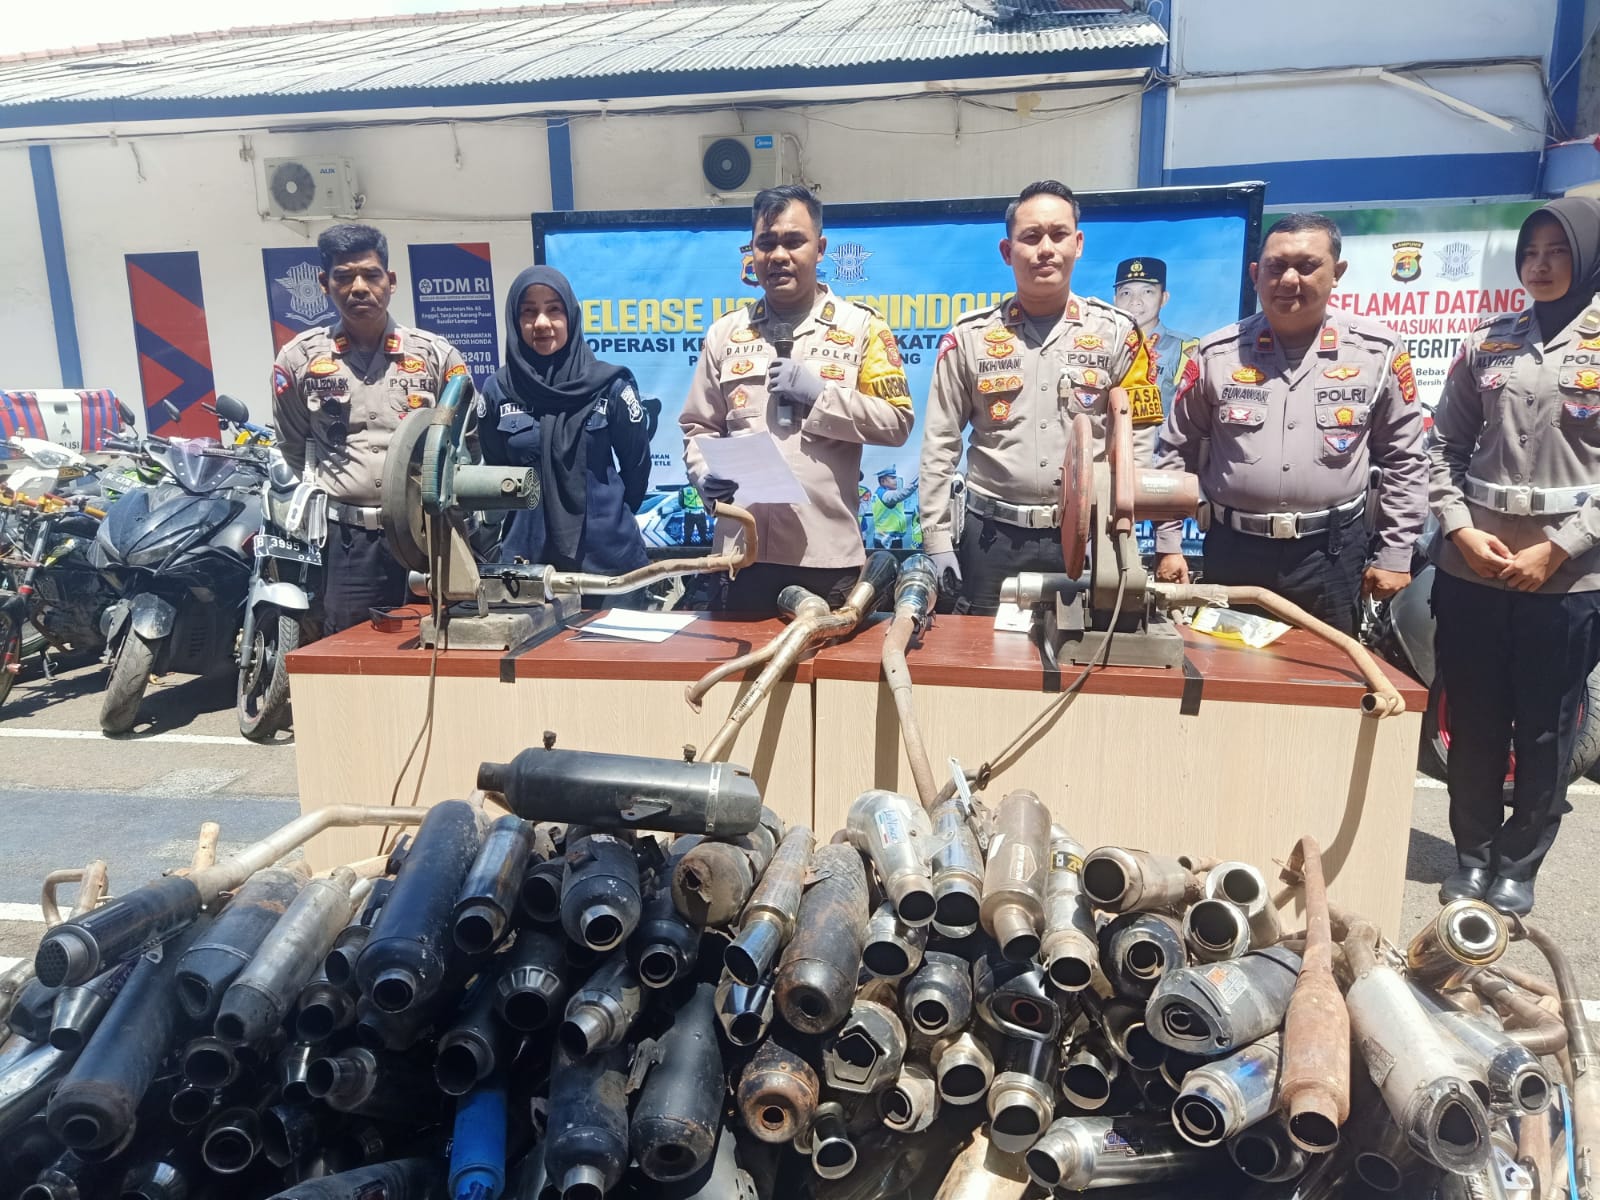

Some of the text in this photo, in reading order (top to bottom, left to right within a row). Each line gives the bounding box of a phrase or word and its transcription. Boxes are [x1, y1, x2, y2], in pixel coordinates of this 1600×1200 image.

[432, 277, 491, 293] TDM RI
[1435, 288, 1526, 314] DATANG
[586, 339, 675, 353] OPERASI
[726, 344, 763, 355] DAVID
[810, 347, 858, 362] POLRI
[1067, 353, 1109, 368] POLRI
[979, 358, 1022, 373] IKHWAN
[1416, 367, 1445, 376] Bebas
[1221, 386, 1269, 401] GUNAWAN
[1317, 388, 1367, 402] POLRI
